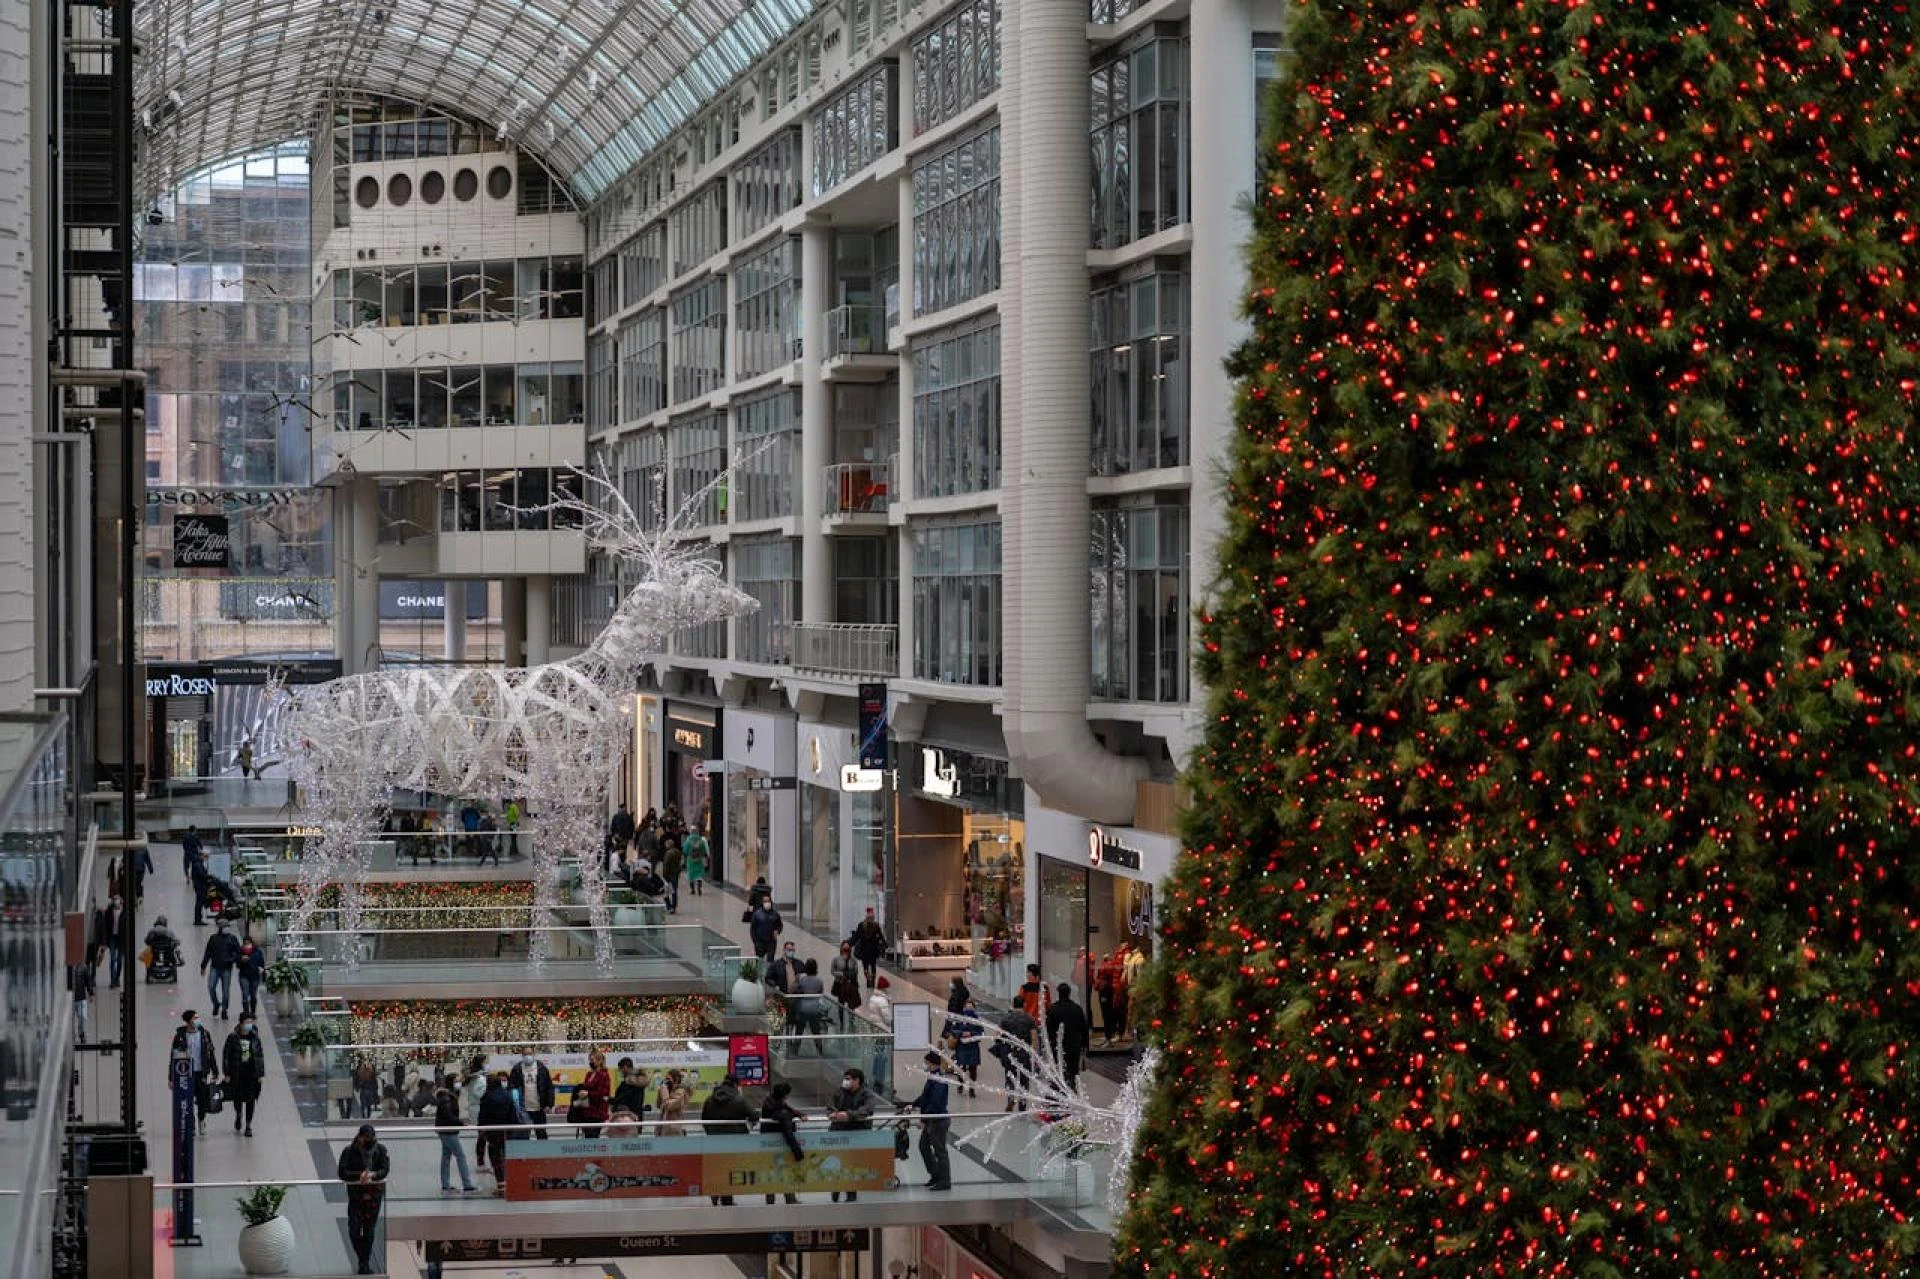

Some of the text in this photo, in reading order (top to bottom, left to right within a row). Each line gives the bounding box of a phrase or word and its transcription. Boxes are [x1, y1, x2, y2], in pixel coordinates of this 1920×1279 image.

[175, 519, 209, 540] Saks
[174, 542, 224, 563] Avenue
[170, 674, 217, 696] ROSEN
[619, 1237, 661, 1249] Queen
